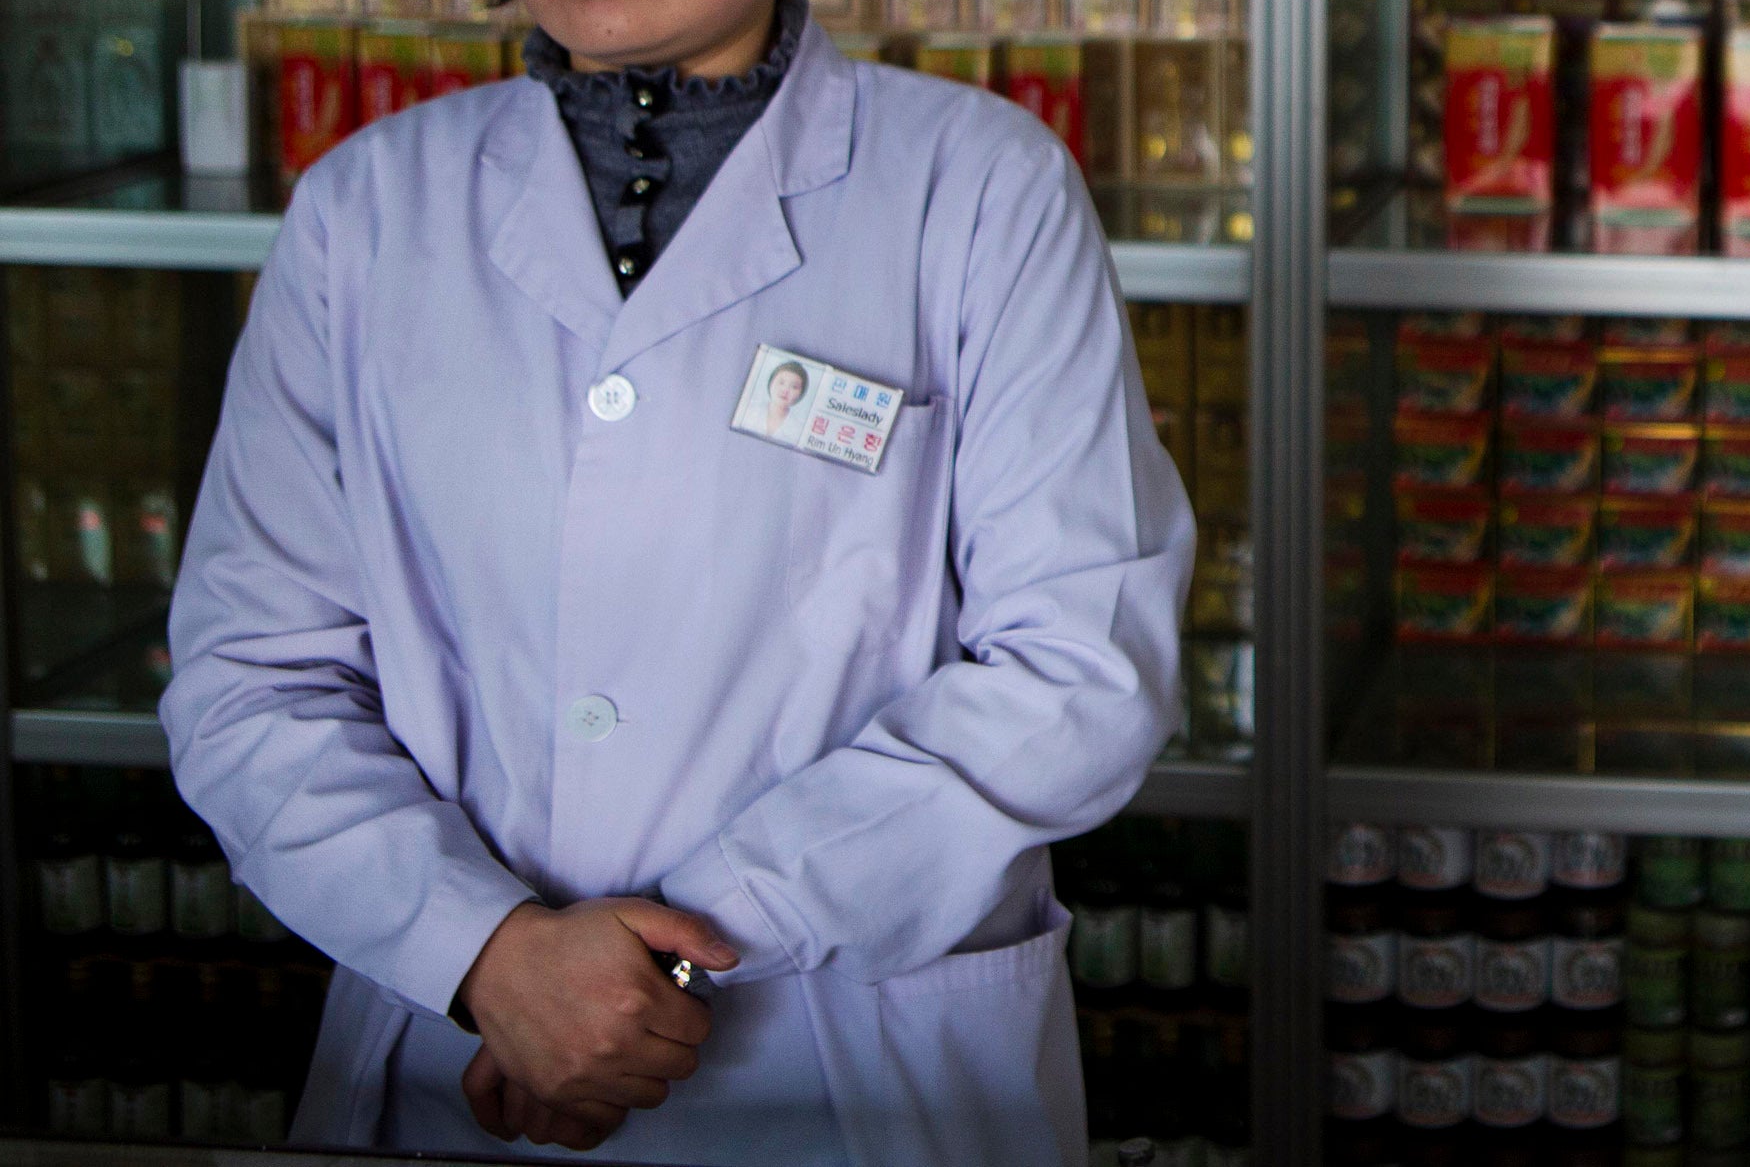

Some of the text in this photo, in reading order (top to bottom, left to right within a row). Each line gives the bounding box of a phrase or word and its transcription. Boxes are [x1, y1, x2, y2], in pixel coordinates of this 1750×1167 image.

[826, 397, 883, 427] Saleslady
[807, 435, 826, 450] Rim
[844, 447, 874, 467] Hyang
